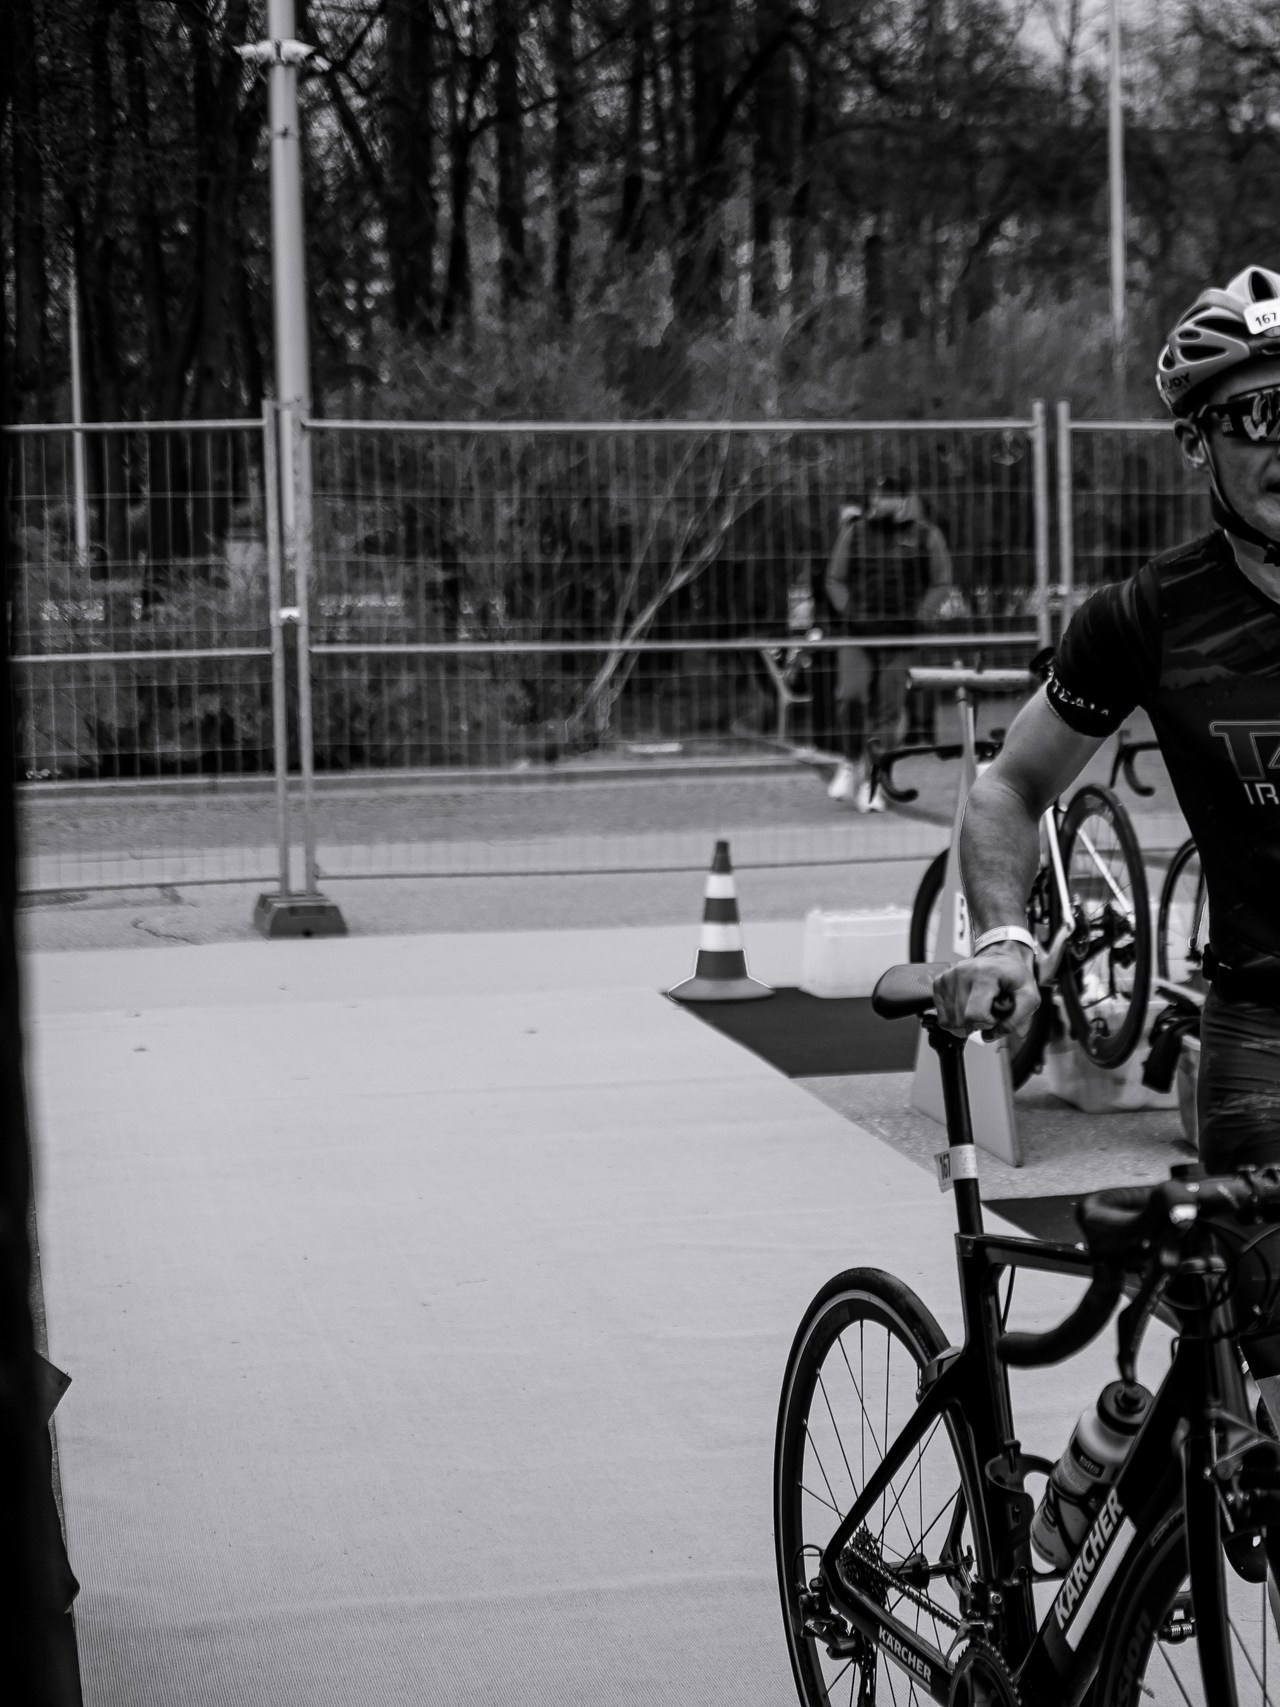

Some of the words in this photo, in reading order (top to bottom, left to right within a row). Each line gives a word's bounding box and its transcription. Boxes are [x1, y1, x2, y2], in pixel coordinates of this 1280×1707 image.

[1254, 312, 1277, 328] 167
[1162, 372, 1190, 390] UDY
[939, 1153, 951, 1180] 167
[1053, 1487, 1124, 1630] KÄRCHER
[879, 1625, 931, 1682] KÄRCHER
